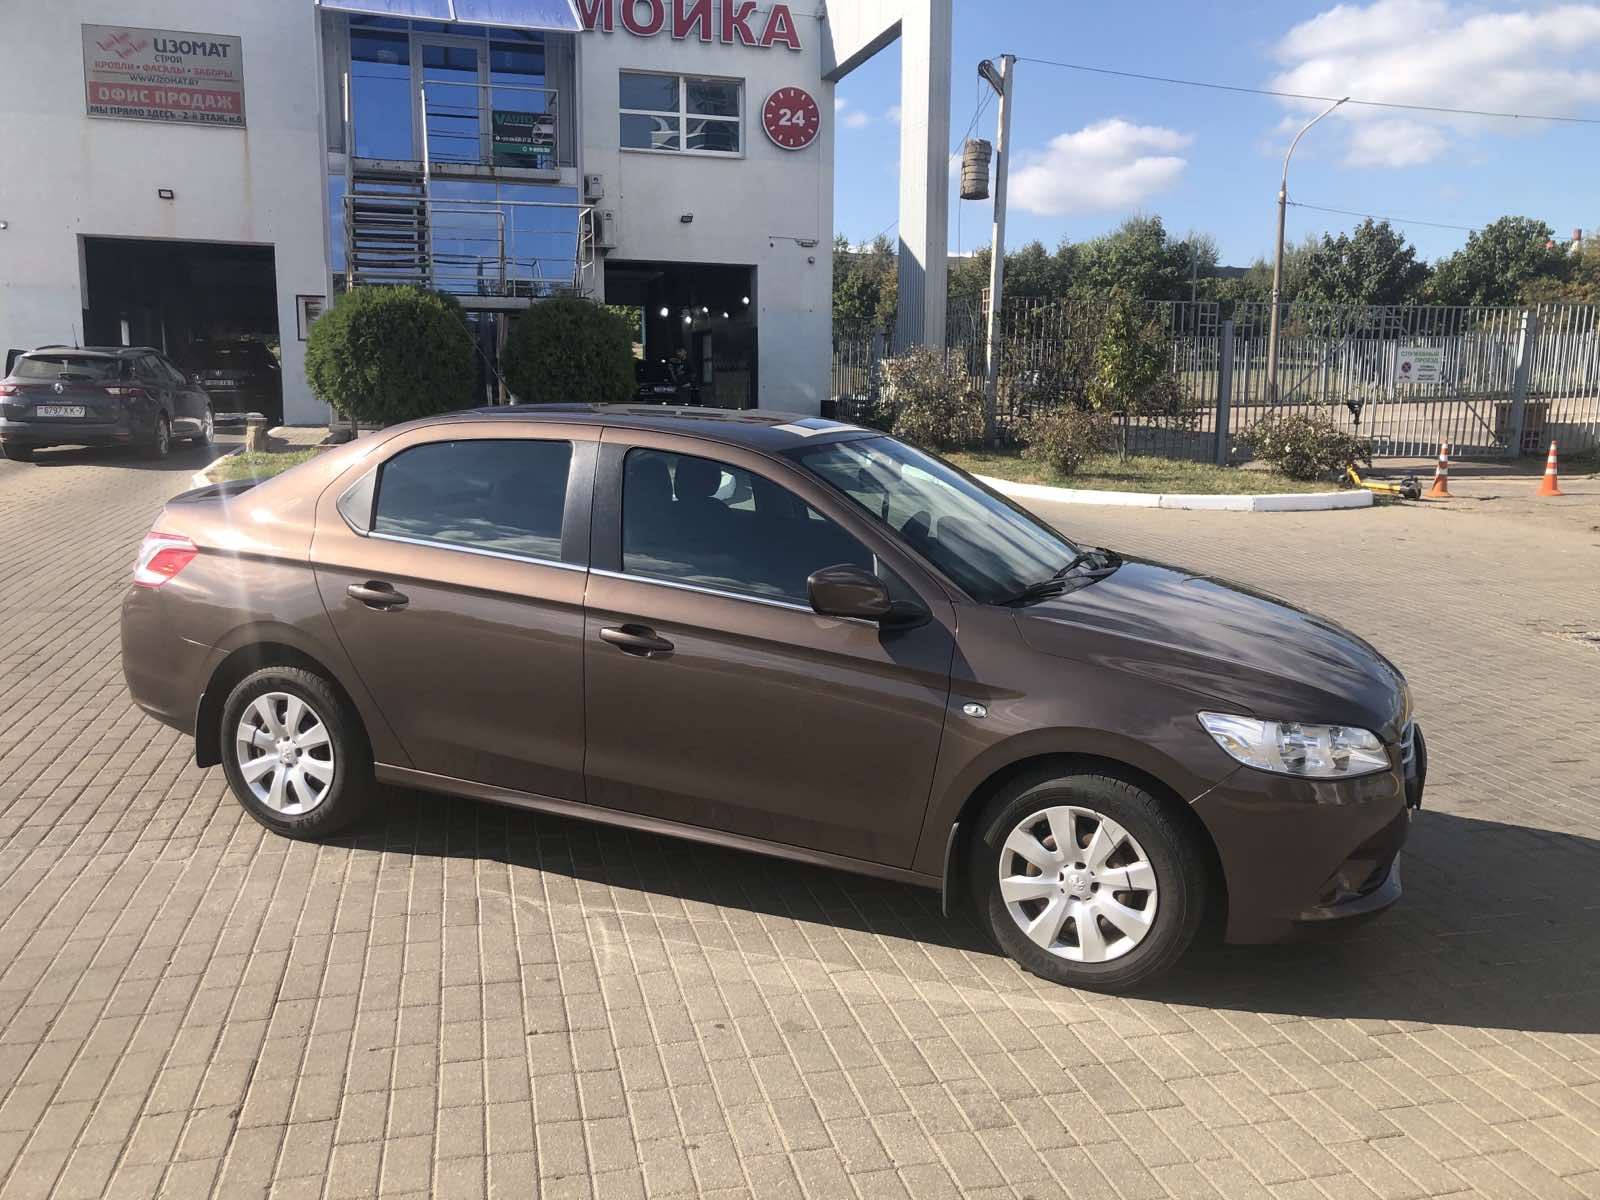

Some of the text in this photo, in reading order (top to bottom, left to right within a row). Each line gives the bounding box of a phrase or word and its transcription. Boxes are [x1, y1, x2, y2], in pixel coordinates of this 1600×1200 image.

[153, 38, 231, 58] ИЗОМАТ
[142, 63, 186, 74] ФАСАДЫ
[98, 86, 233, 110] ОФИС ПРОДАЖ
[90, 105, 108, 114] МЫ
[109, 106, 145, 116] ПРЯМО
[778, 108, 806, 127] 24
